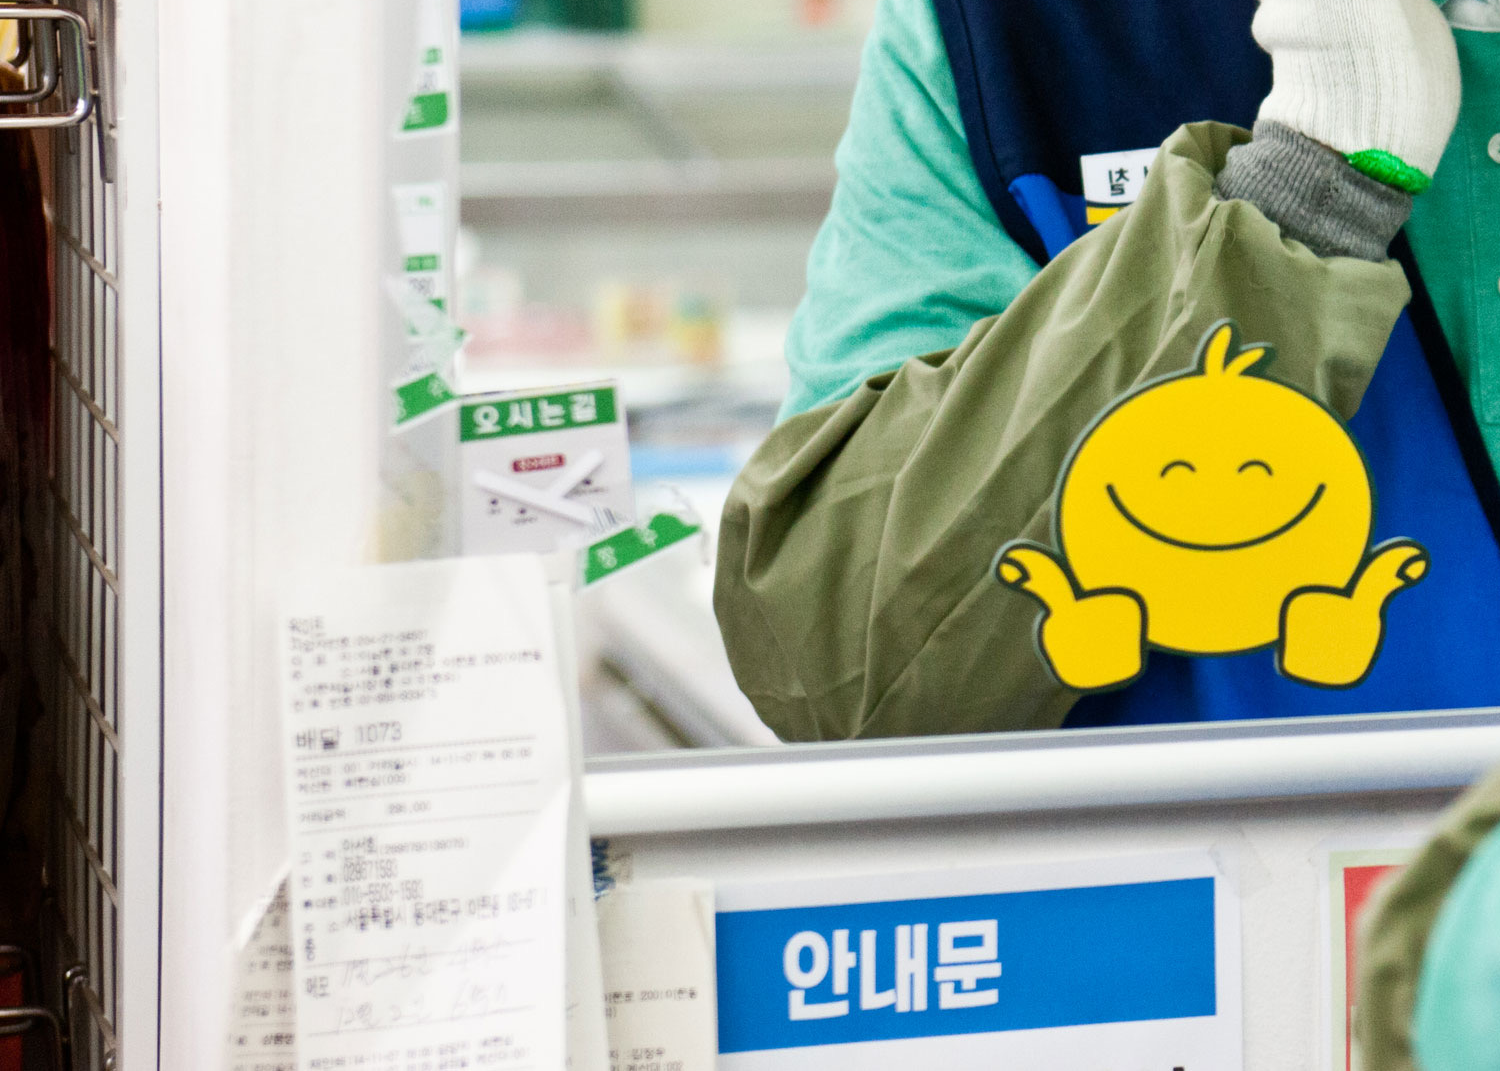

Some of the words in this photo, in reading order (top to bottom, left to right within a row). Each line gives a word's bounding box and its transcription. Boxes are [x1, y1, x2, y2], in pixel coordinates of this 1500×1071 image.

[473, 393, 597, 435] 오시는길
[295, 726, 342, 751] 배달
[354, 721, 403, 744] 1073
[782, 918, 1003, 1022] 안내문
